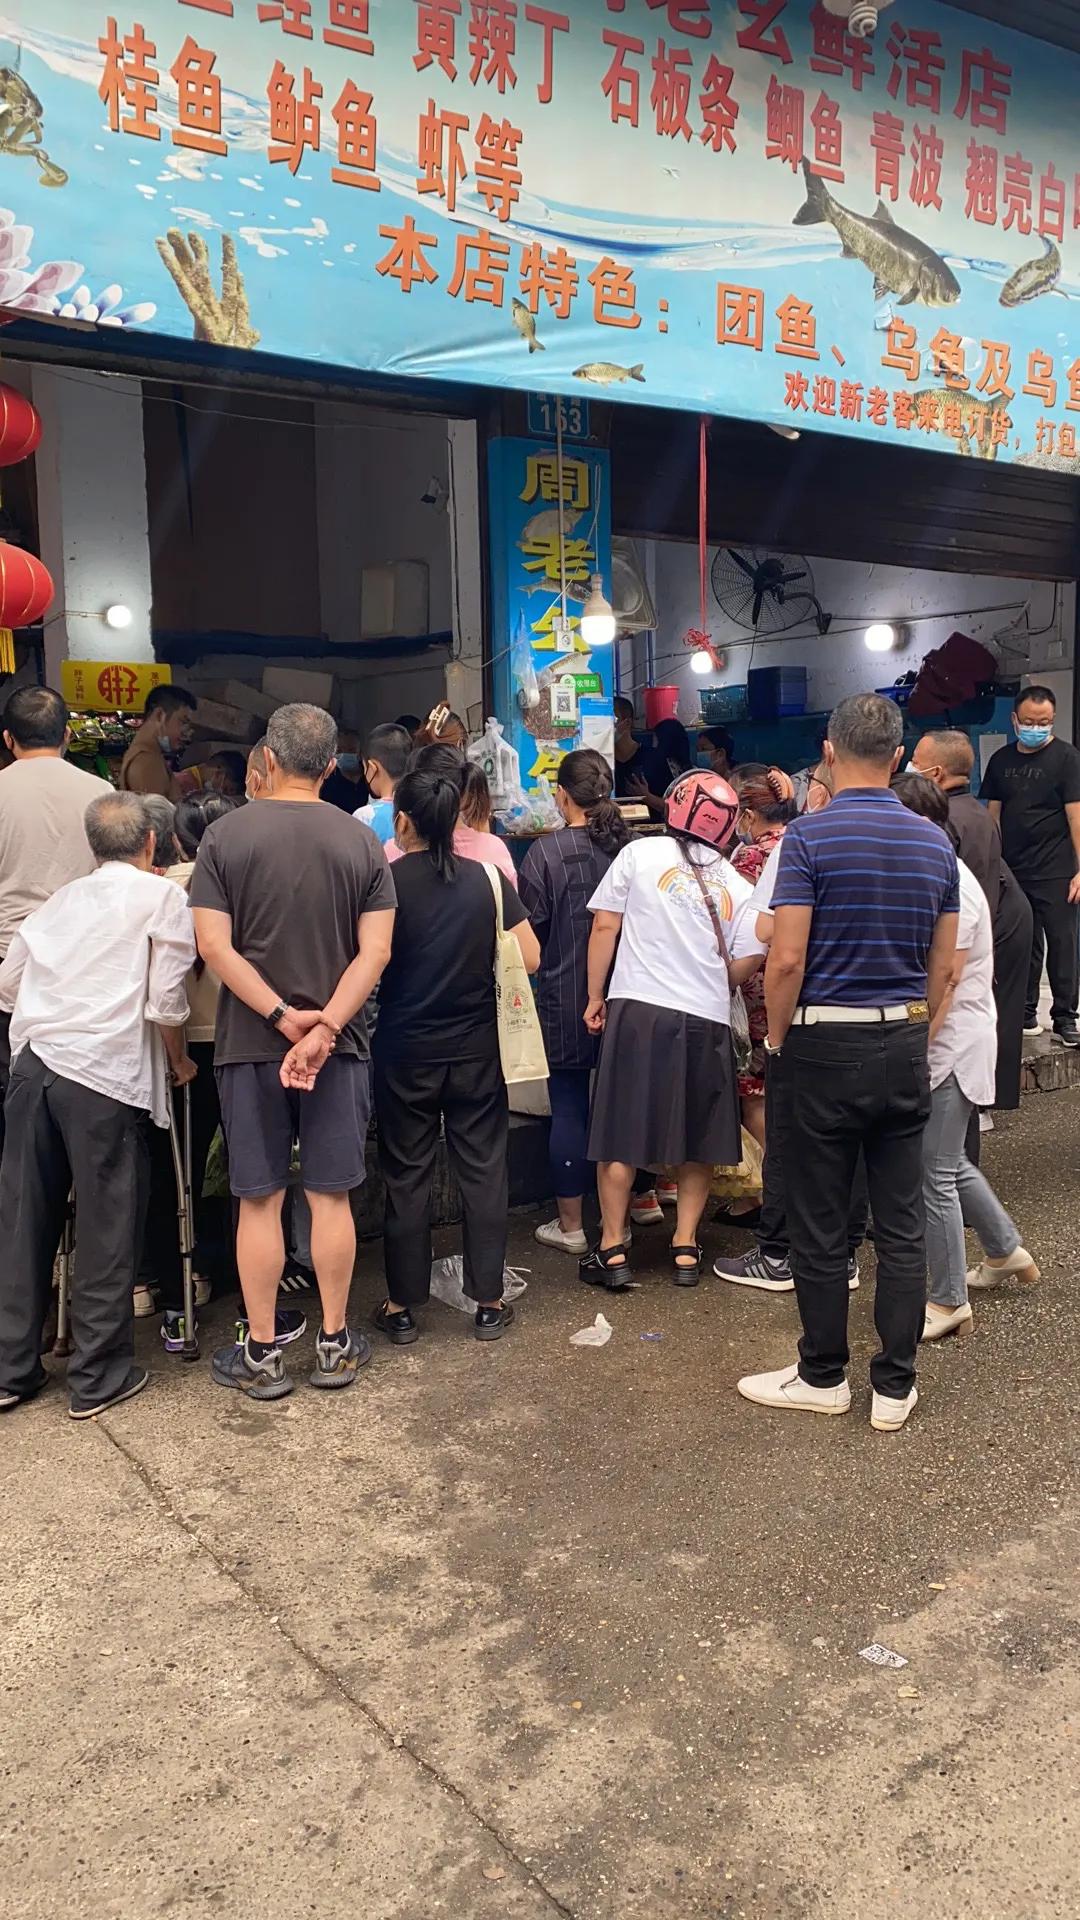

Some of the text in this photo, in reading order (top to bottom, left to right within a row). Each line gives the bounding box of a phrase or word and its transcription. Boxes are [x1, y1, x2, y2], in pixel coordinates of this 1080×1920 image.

[98, 16, 523, 222] 桂鱼 鲈鱼 虾等
[412, 0, 570, 104] 黄辣丁
[600, 28, 740, 154] 石板条
[765, 73, 846, 184] 鲫鱼
[869, 110, 945, 212] 青波
[964, 136, 1080, 243] 翘壳白
[376, 215, 1080, 411] 本店特色：团鱼、乌龟及乌
[540, 404, 582, 434] 163
